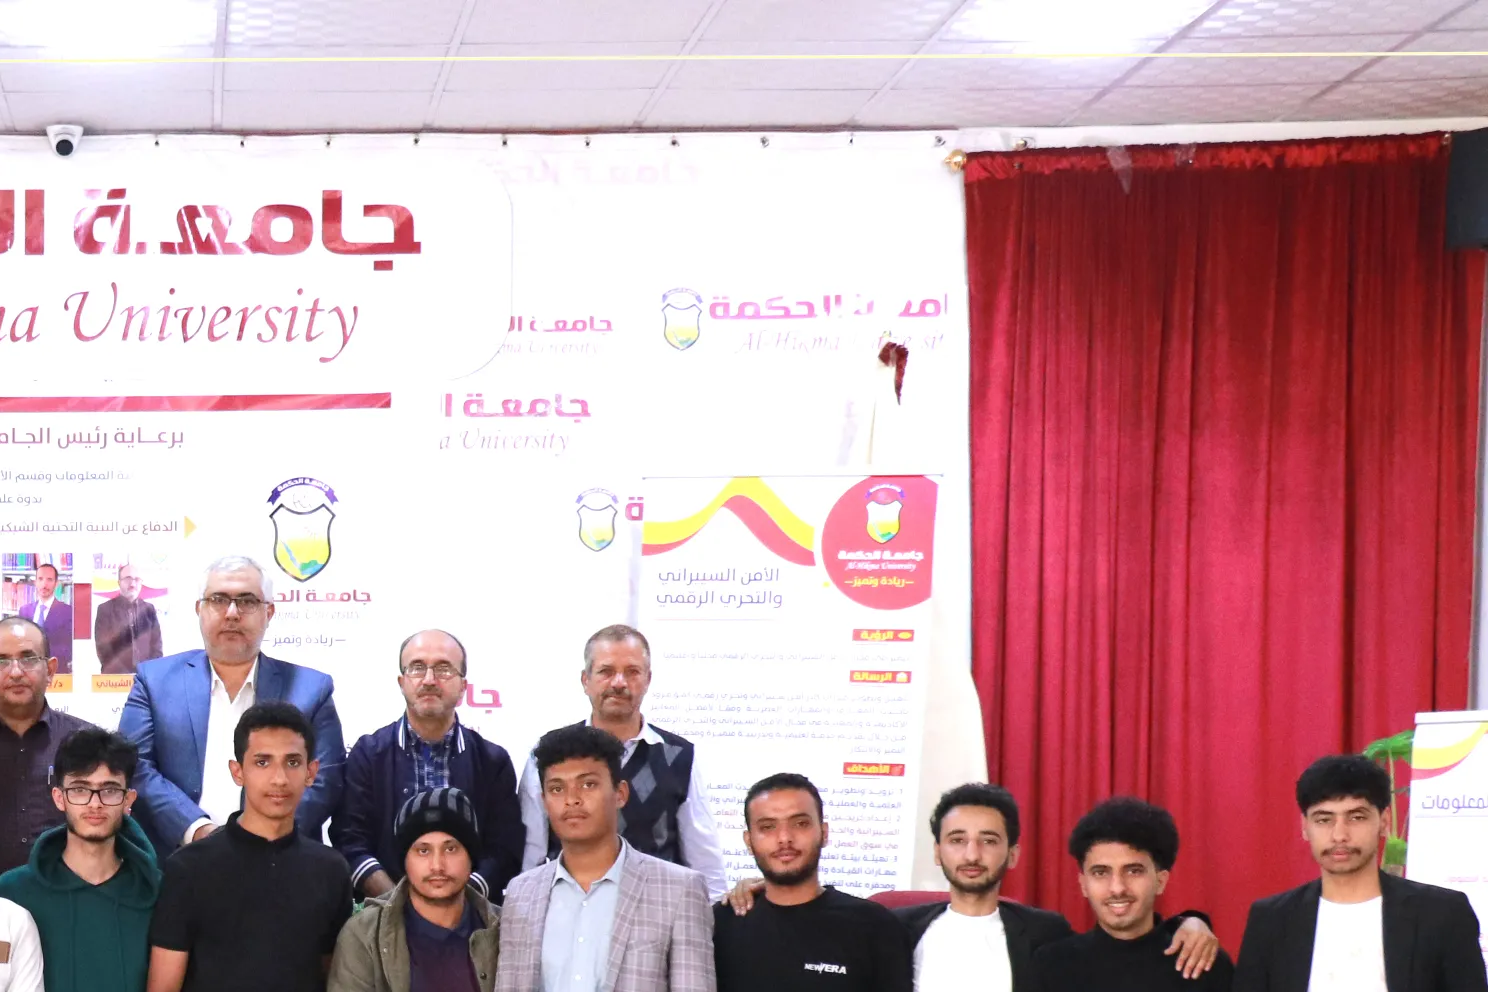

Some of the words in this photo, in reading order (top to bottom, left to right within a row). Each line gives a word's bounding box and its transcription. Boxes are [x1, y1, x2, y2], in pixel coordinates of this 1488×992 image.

[72, 188, 422, 271] جامعة
[63, 282, 359, 363] University
[463, 393, 592, 424] جامعة
[57, 426, 108, 450] رئيس
[114, 427, 184, 449] برعاية
[460, 428, 570, 457] University
[42, 521, 82, 535] التحتية
[122, 524, 138, 535] عن
[142, 520, 178, 535] الدفاع
[659, 567, 735, 586] السيبراني
[741, 567, 779, 586] الأمن
[272, 589, 300, 602] الح
[305, 588, 372, 606] جامعة
[656, 590, 714, 608] الرقمي
[720, 591, 782, 608] والتحري
[1421, 793, 1488, 814] لمعلومات
